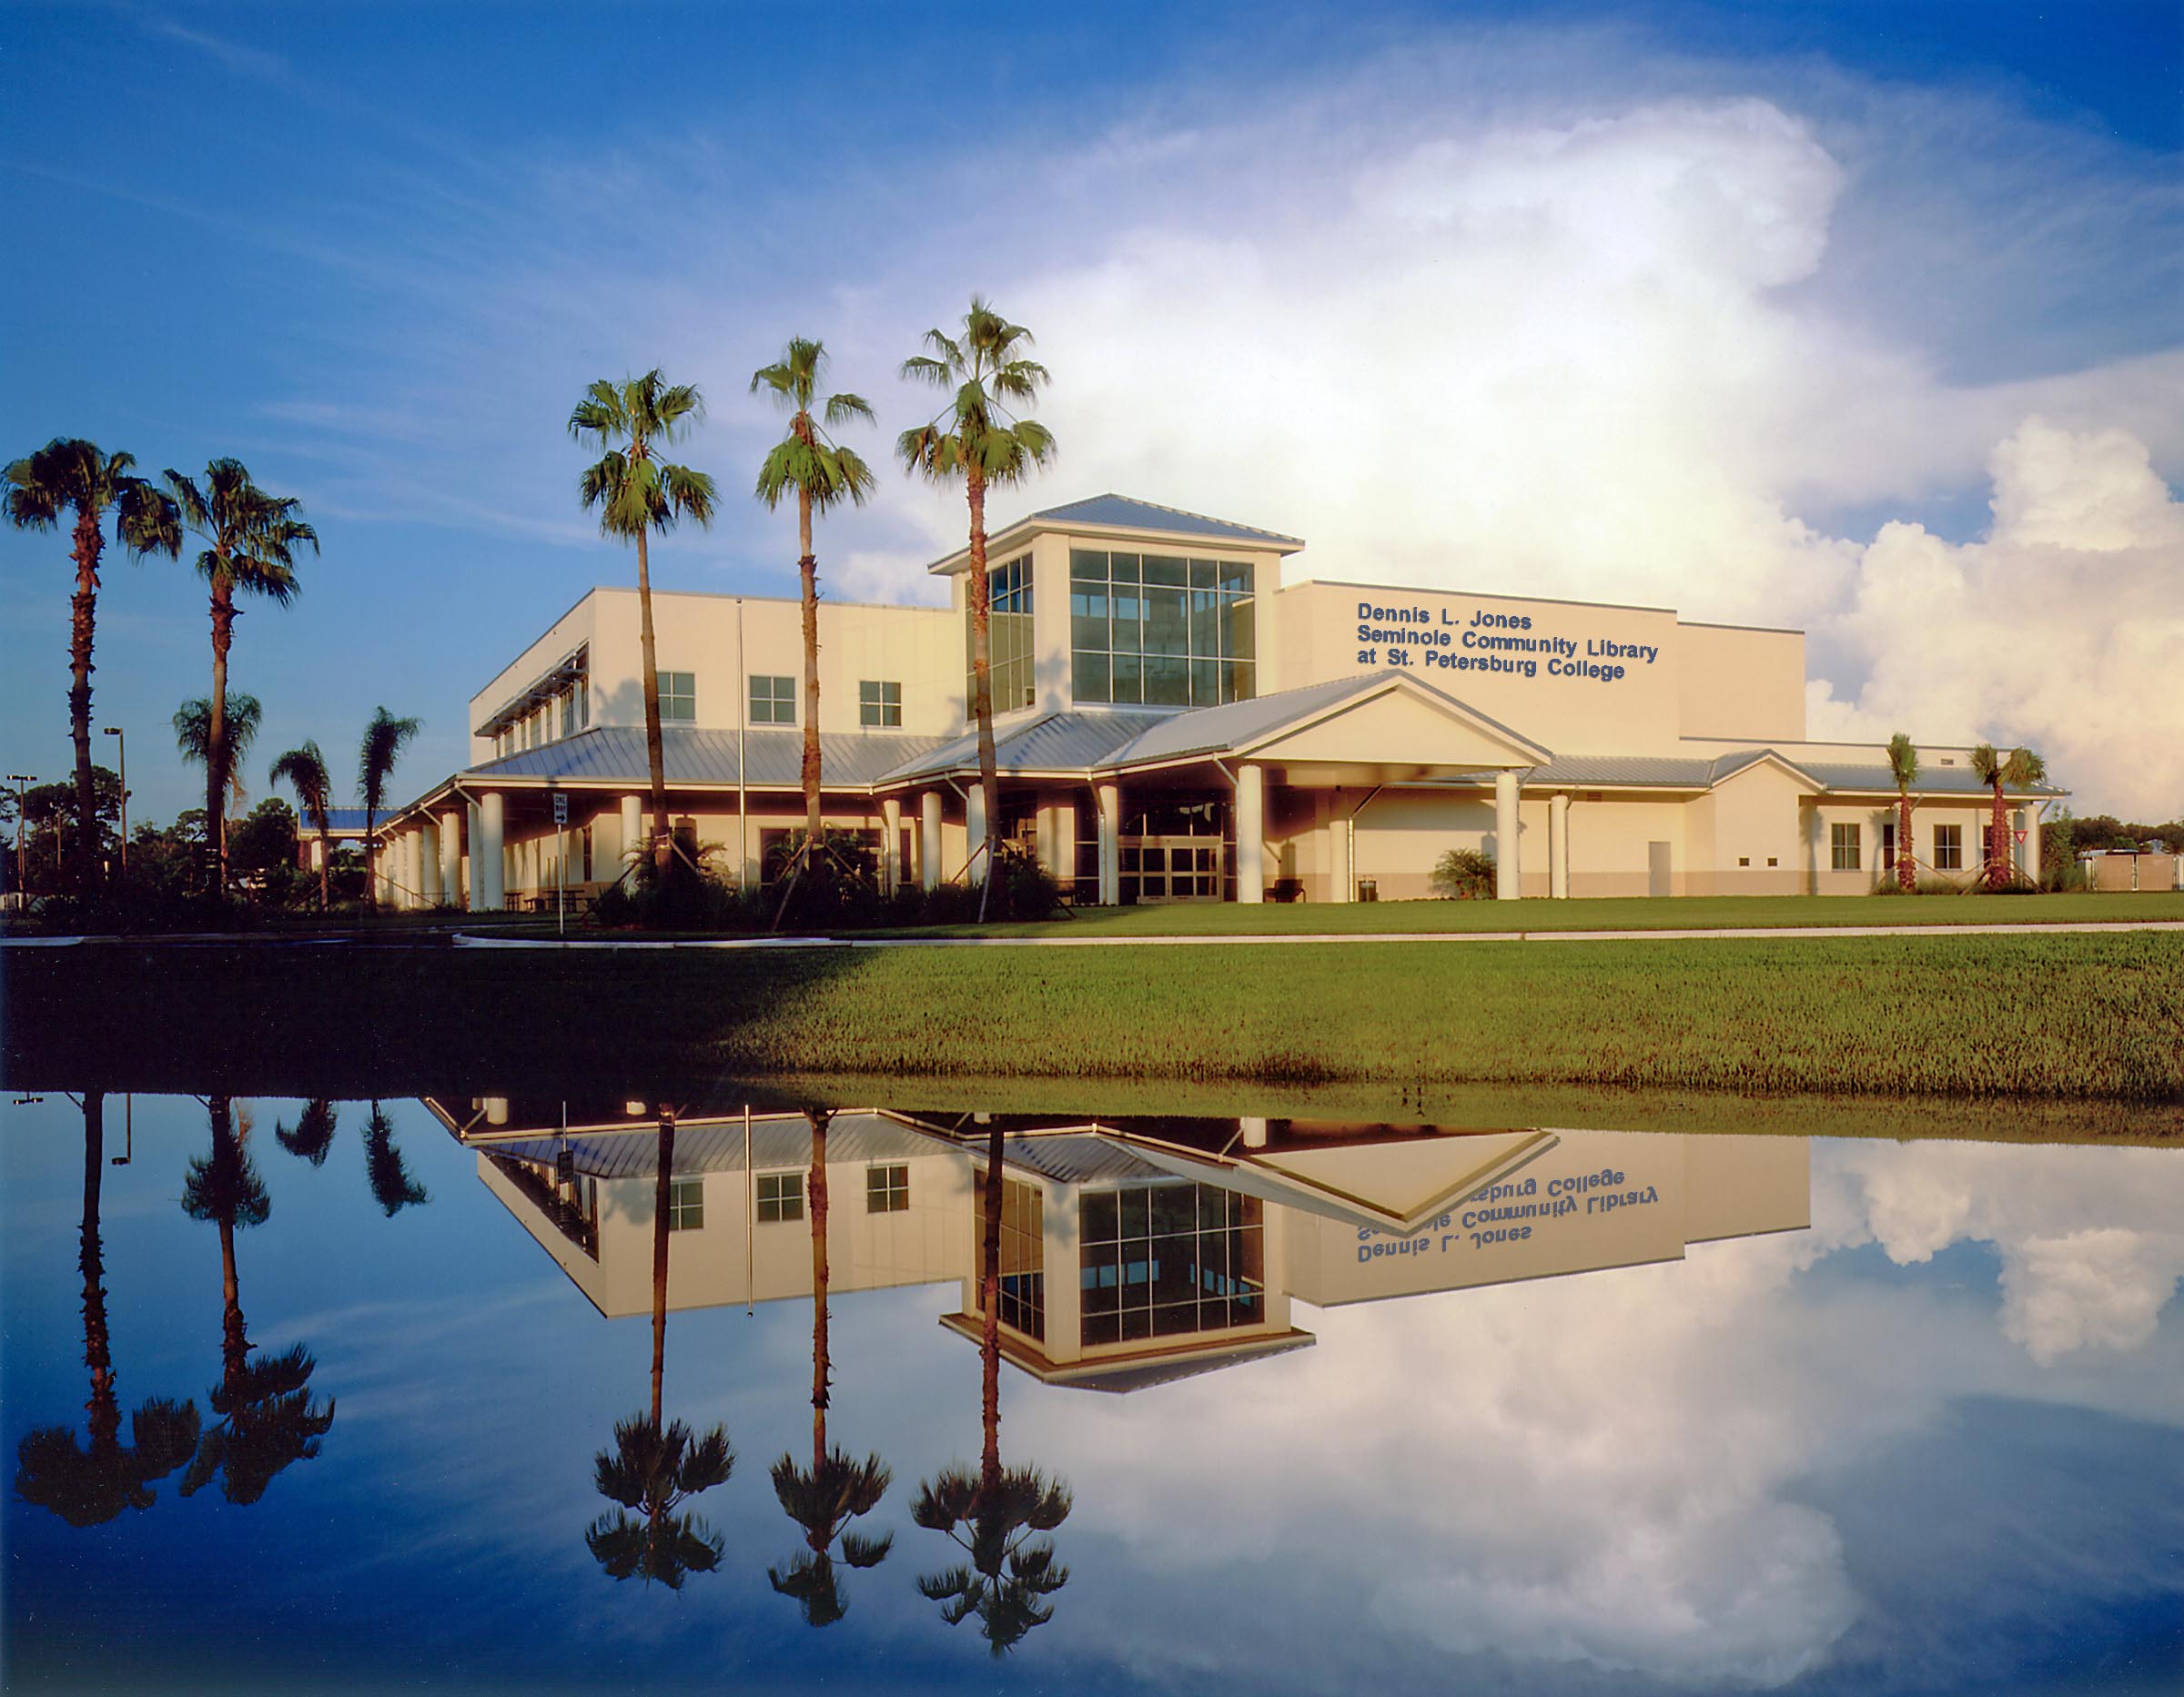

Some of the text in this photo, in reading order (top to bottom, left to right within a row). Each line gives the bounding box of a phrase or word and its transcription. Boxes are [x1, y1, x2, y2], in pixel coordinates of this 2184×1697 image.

[1358, 602, 1532, 630] Dennis L. Jones
[1358, 624, 1658, 663] Seminole Community Library
[1357, 649, 1625, 682] at St. Petersburg College
